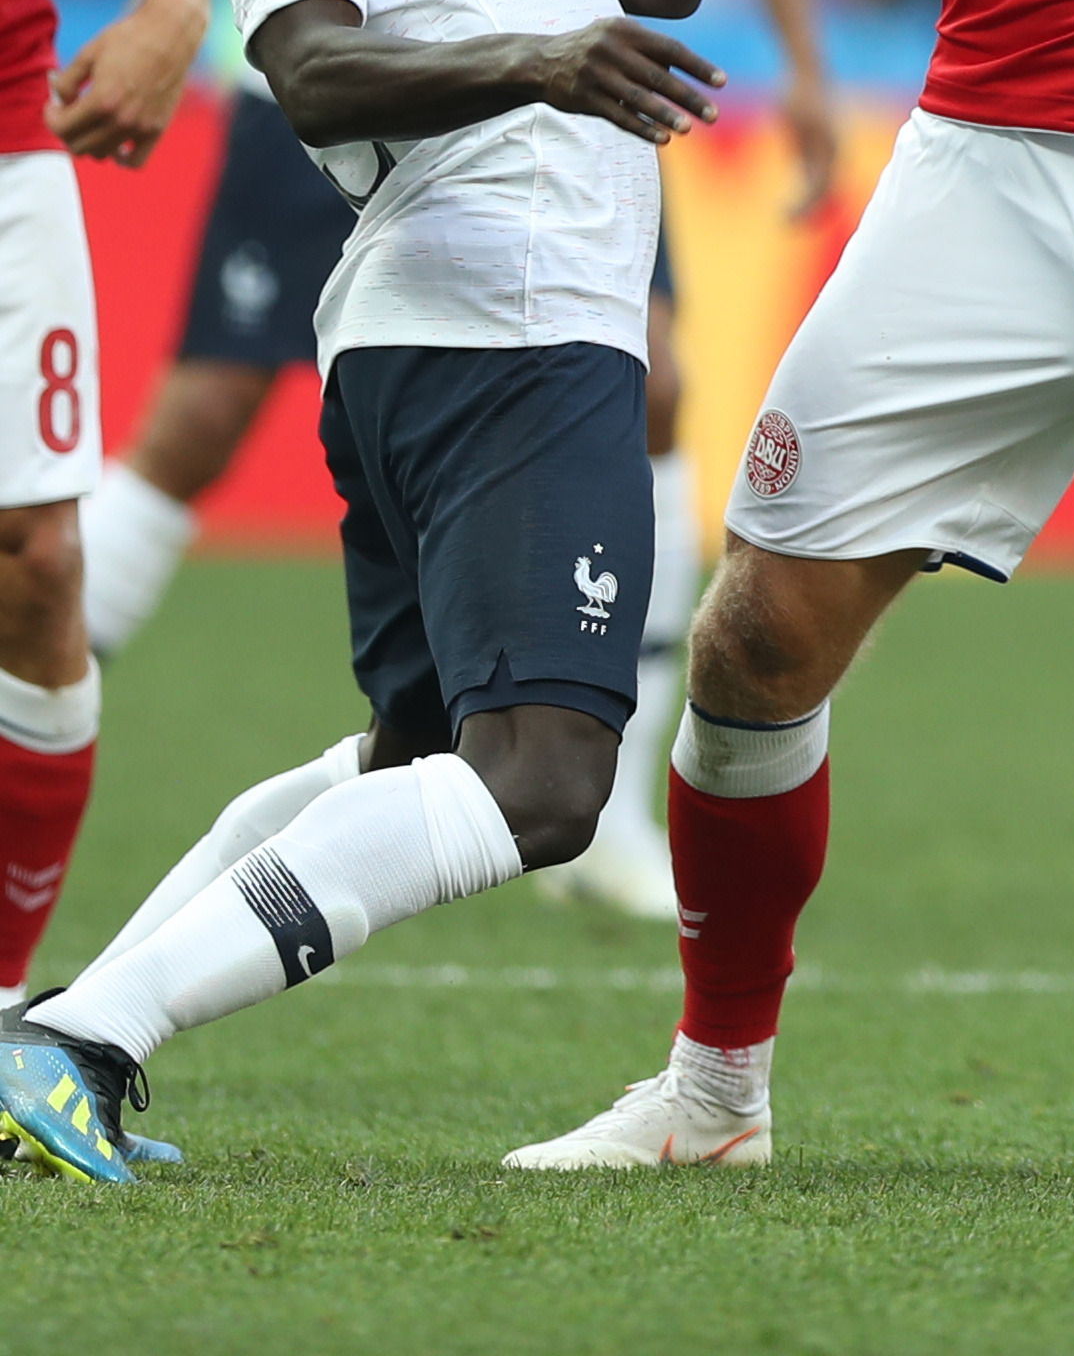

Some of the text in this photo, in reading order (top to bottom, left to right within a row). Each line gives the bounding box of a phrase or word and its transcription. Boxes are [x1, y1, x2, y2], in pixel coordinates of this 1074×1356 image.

[39, 328, 80, 454] 8
[754, 433, 786, 471] DBU
[774, 450, 798, 491] UNION
[580, 620, 607, 636] FFF
